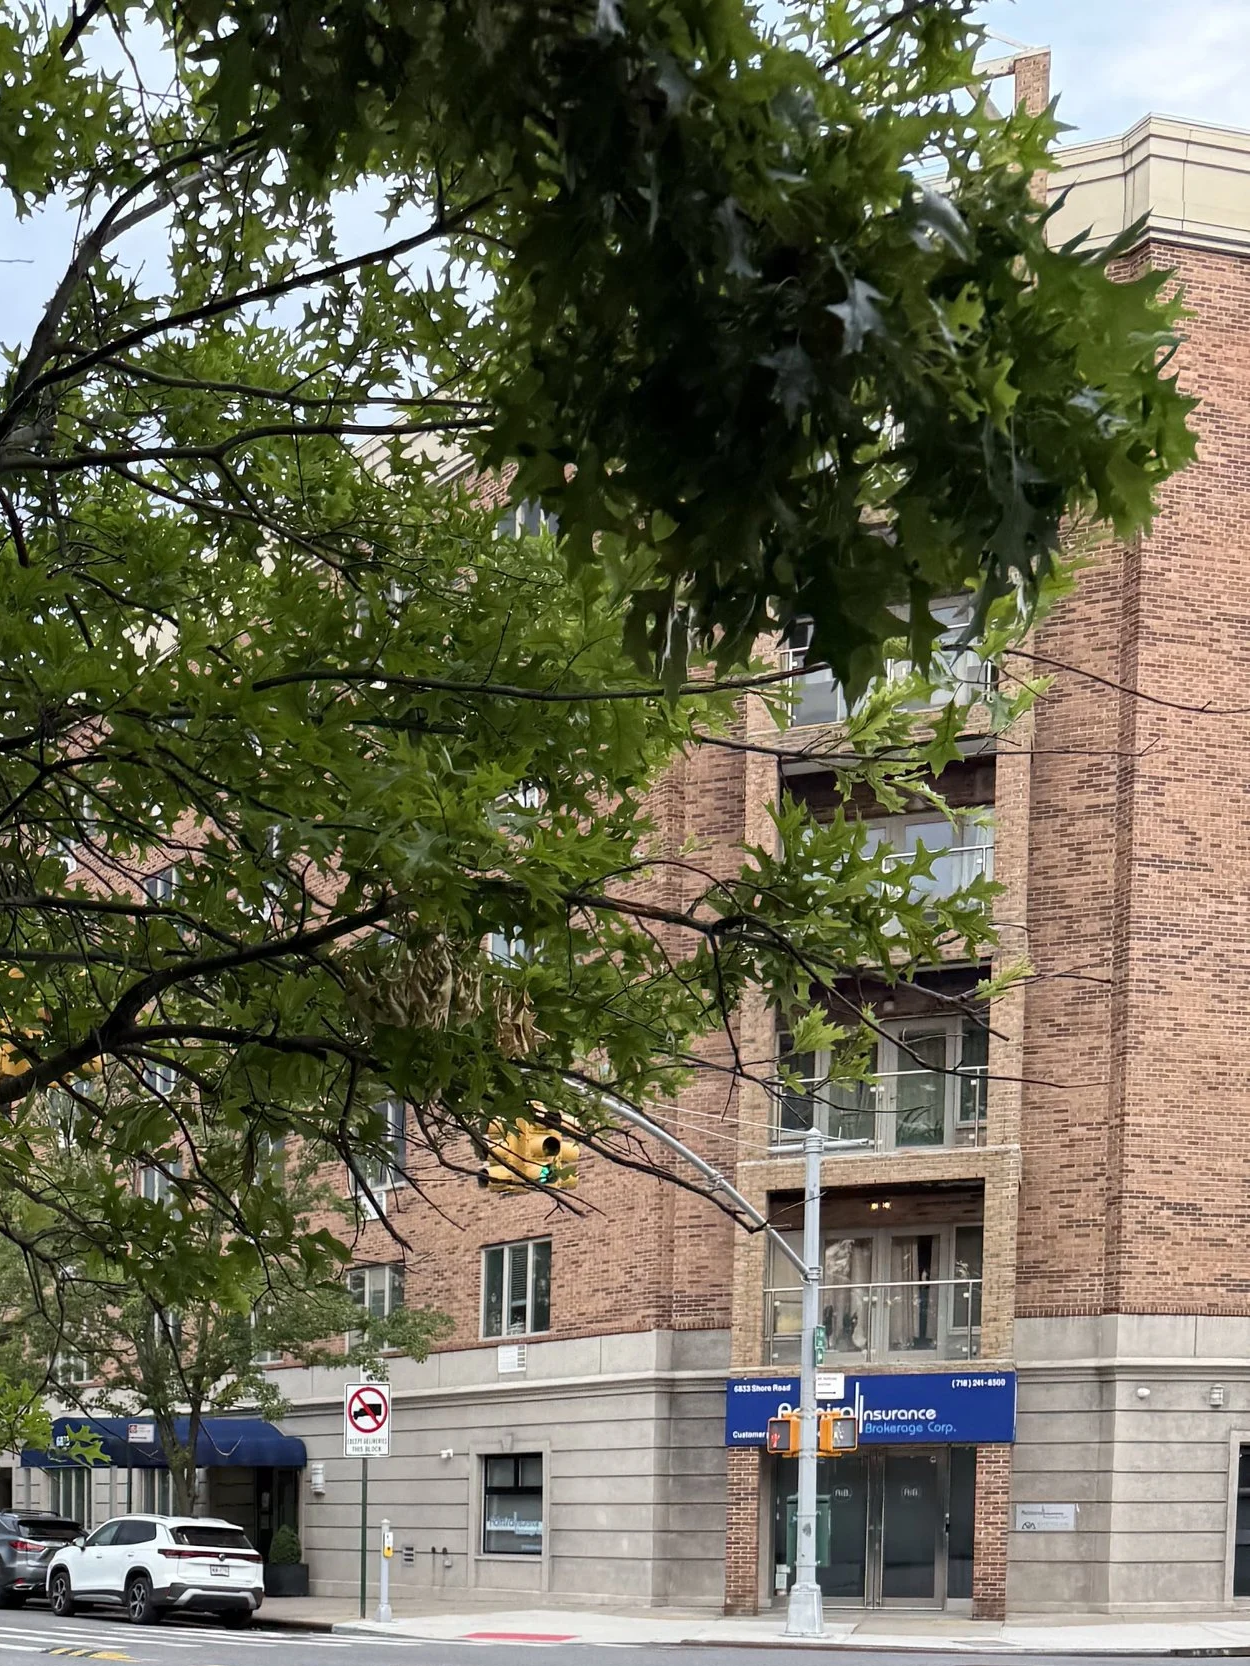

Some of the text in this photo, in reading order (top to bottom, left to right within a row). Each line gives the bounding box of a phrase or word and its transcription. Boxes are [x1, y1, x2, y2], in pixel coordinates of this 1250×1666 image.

[751, 1384, 771, 1392] Shore
[773, 1383, 792, 1392] Road
[864, 1421, 957, 1436] Brokerage Corp.
[732, 1430, 766, 1440] Customer
